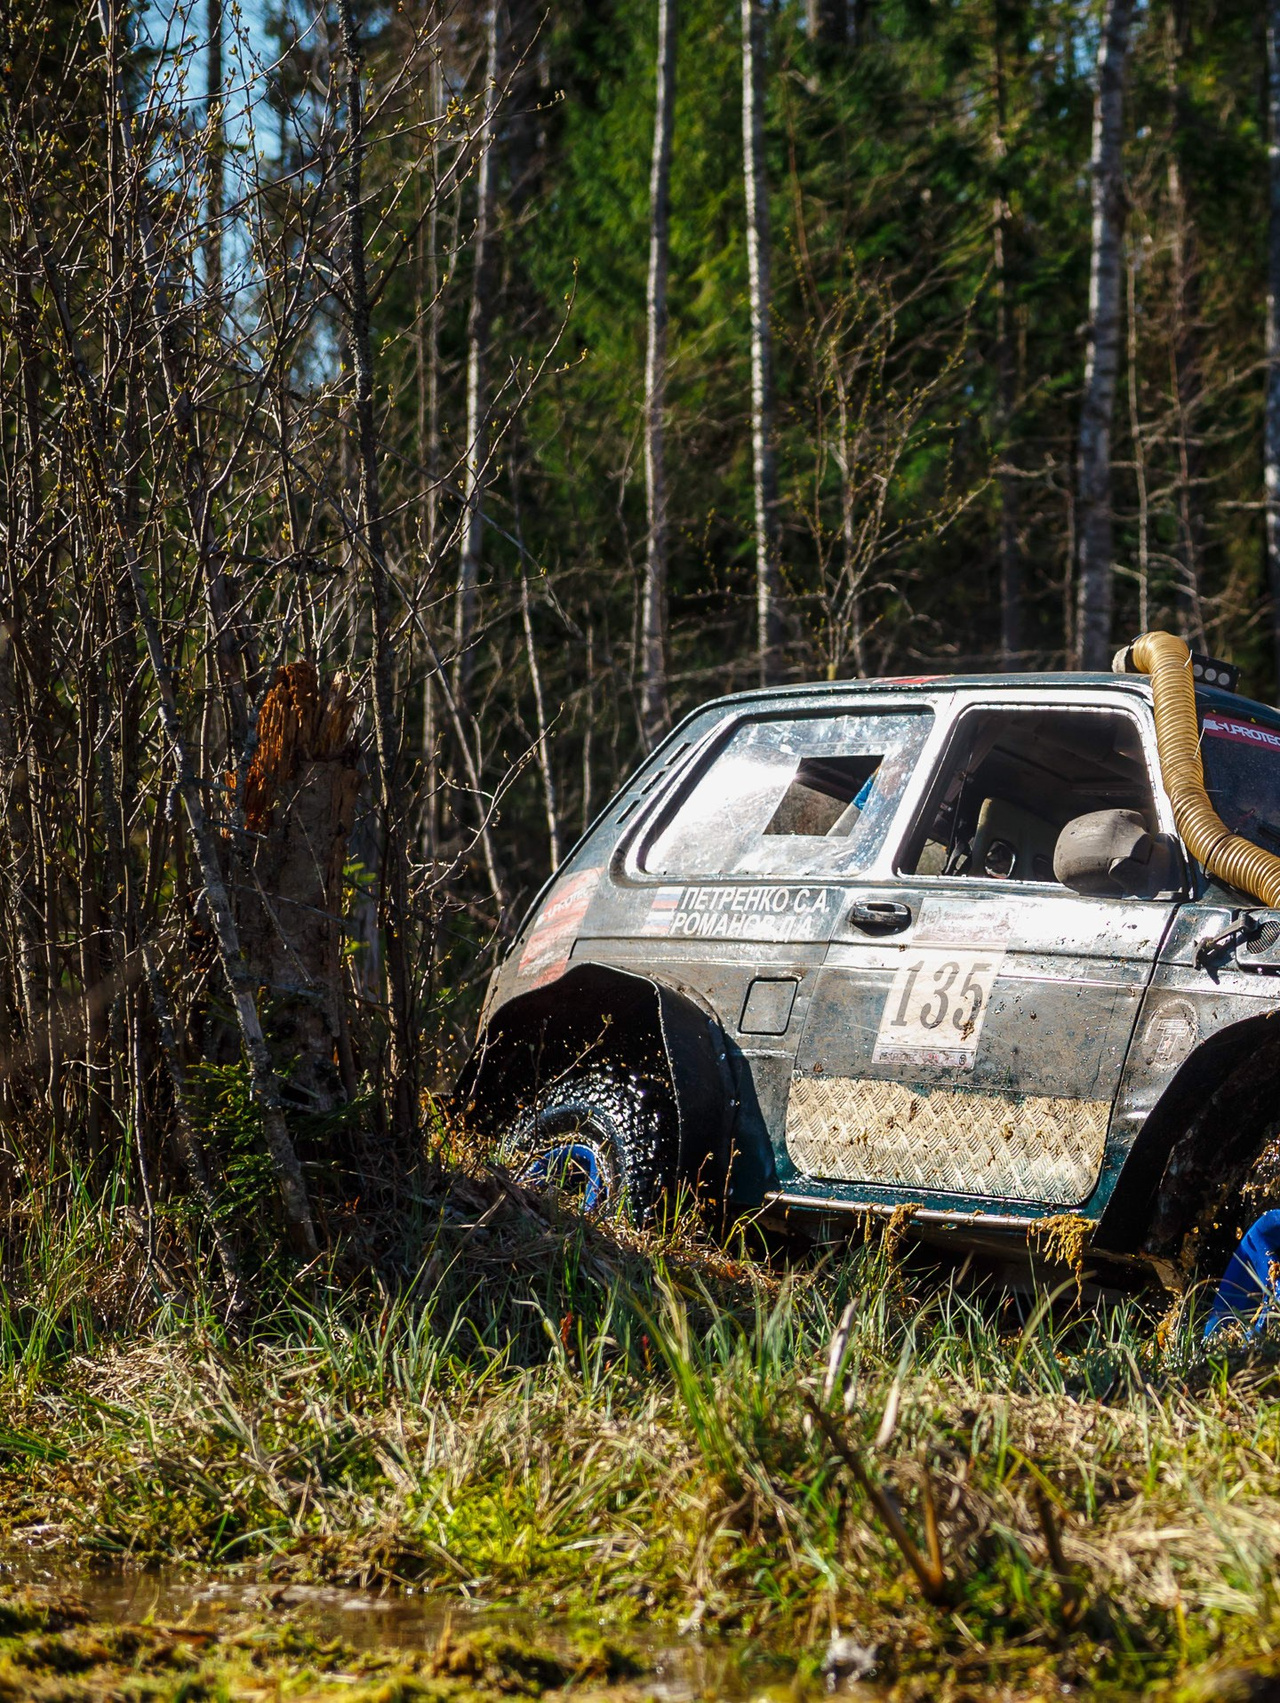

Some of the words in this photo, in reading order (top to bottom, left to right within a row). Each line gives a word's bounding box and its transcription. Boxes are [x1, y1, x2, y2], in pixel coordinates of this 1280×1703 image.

[681, 887, 789, 913] ПЕТРЕНКО
[669, 912, 777, 938] РОМАНОВ
[889, 960, 993, 1031] 135
